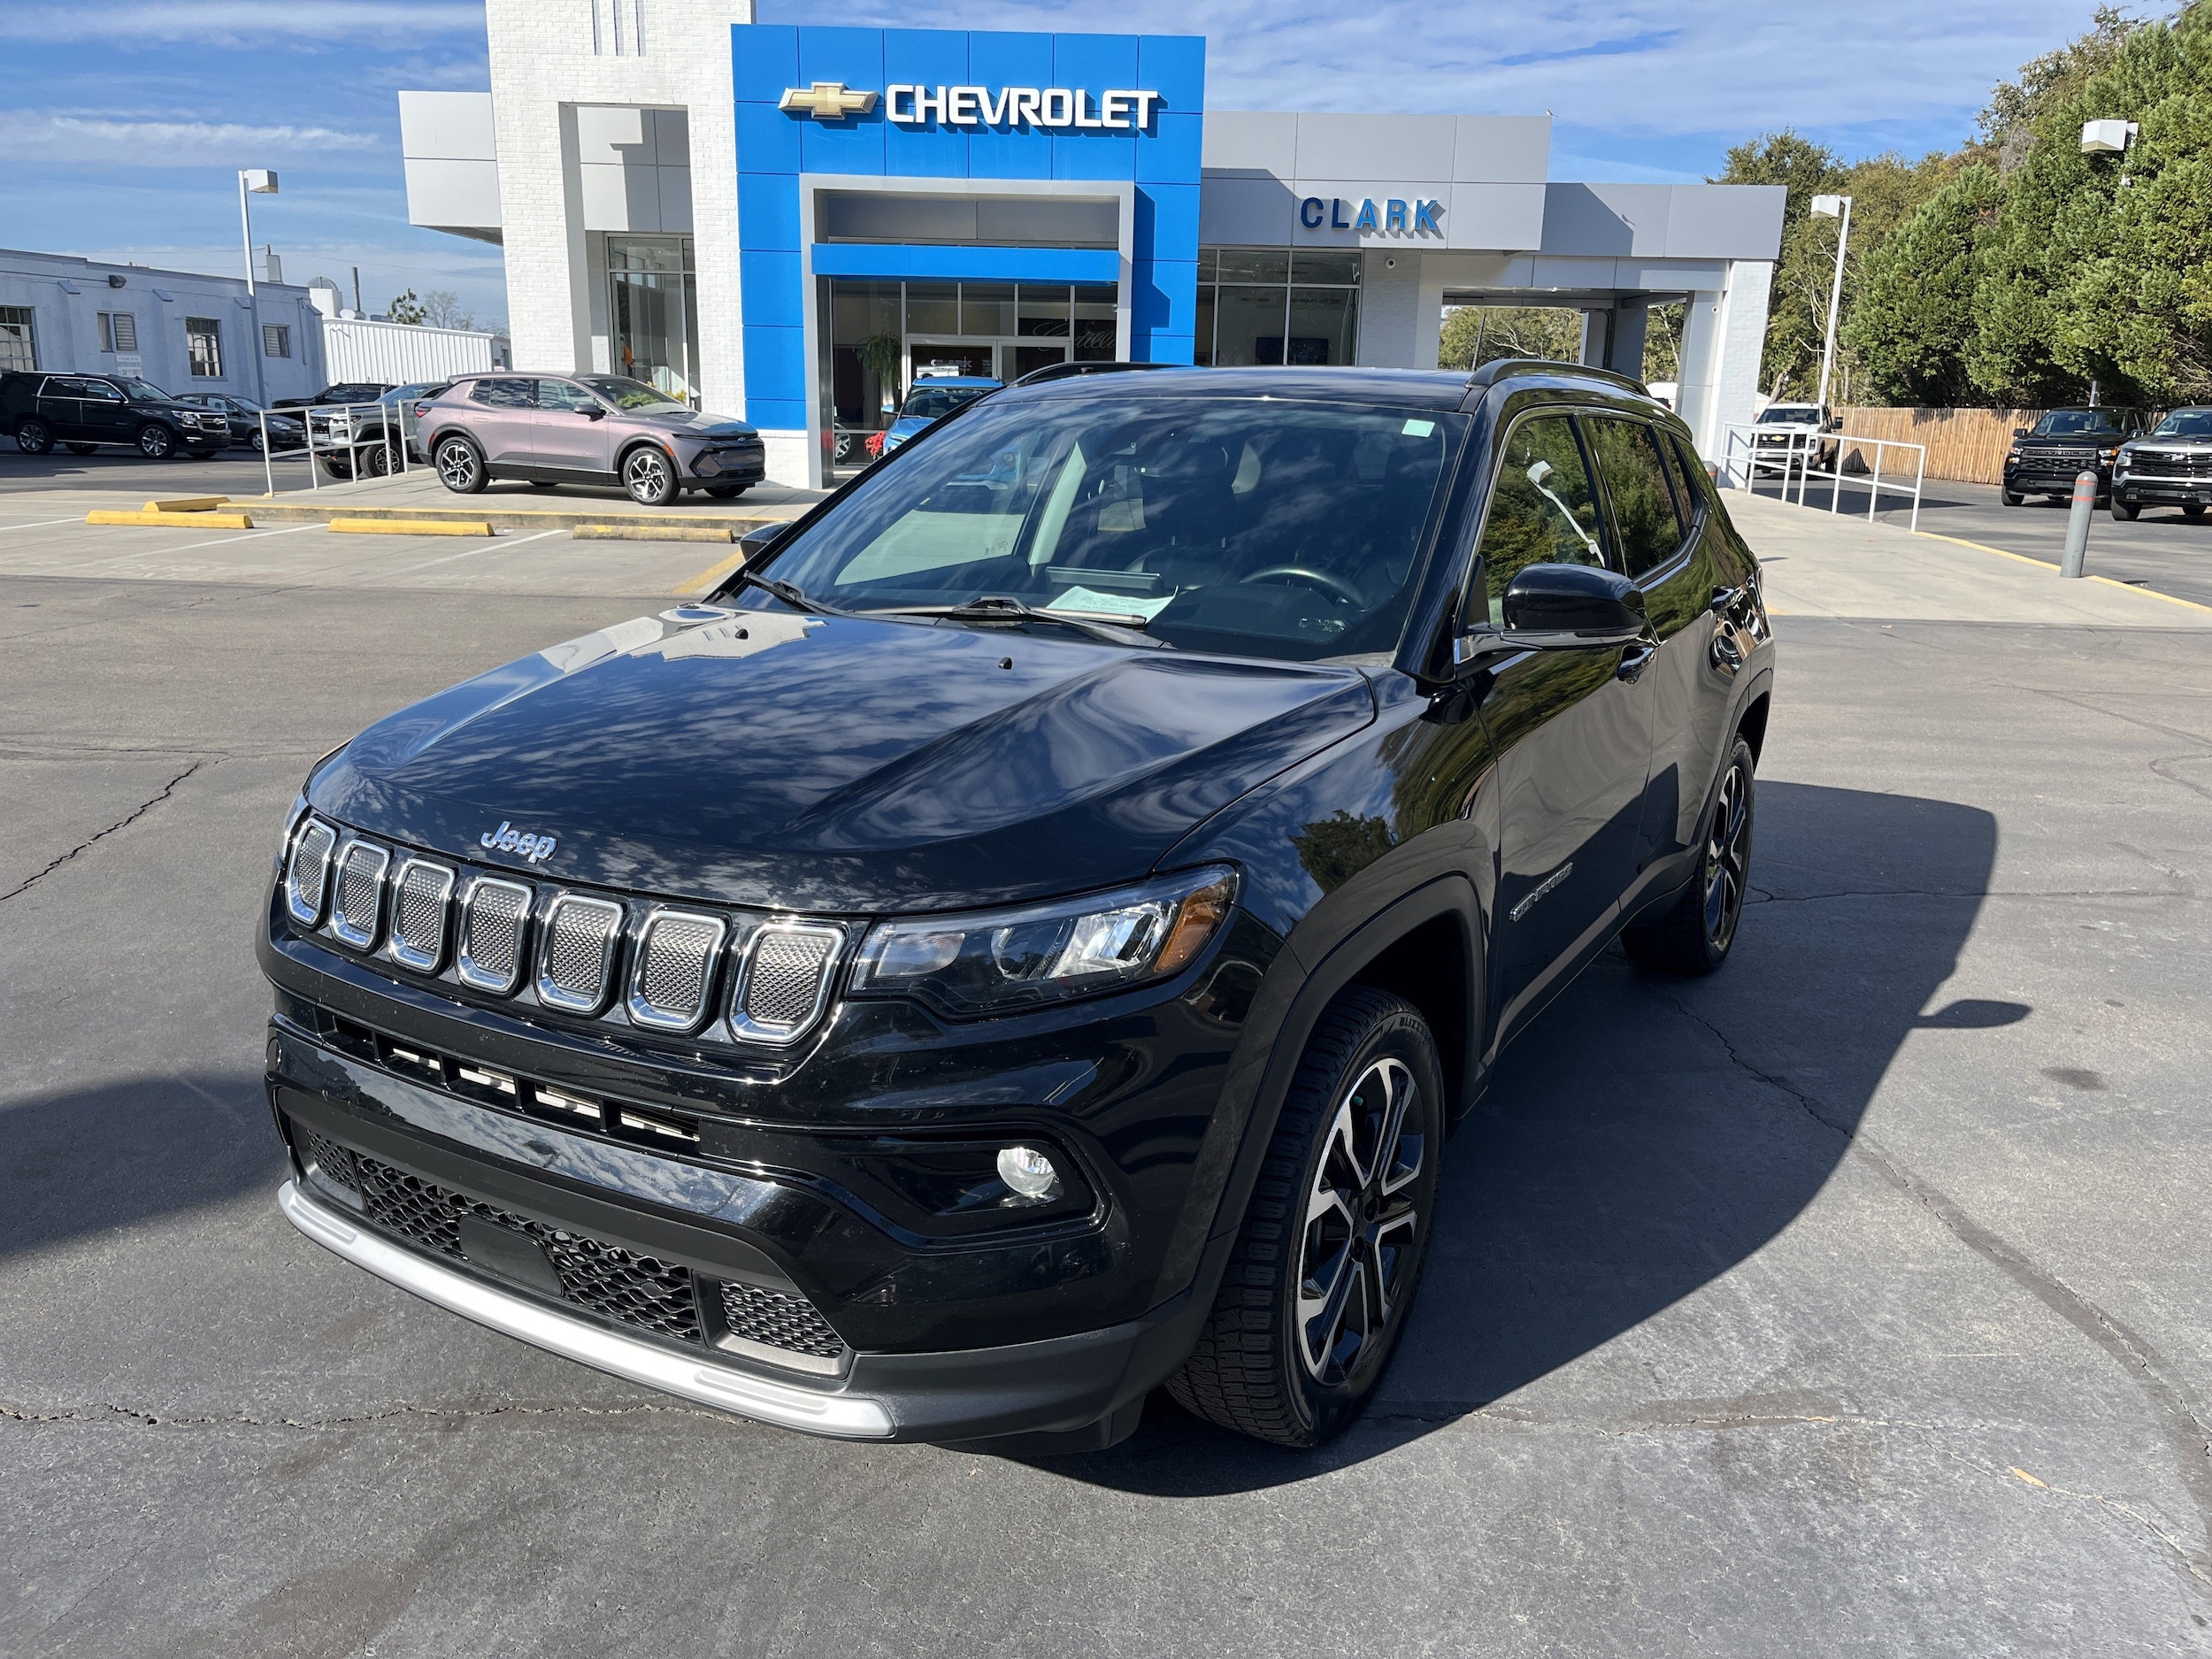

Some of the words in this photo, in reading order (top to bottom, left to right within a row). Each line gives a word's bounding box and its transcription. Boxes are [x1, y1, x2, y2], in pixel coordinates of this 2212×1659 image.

[886, 83, 1158, 129] CHEVROLET
[1300, 196, 1438, 232] CLARK
[480, 820, 558, 864] Jeep
[1509, 862, 1574, 923] COMPASS
